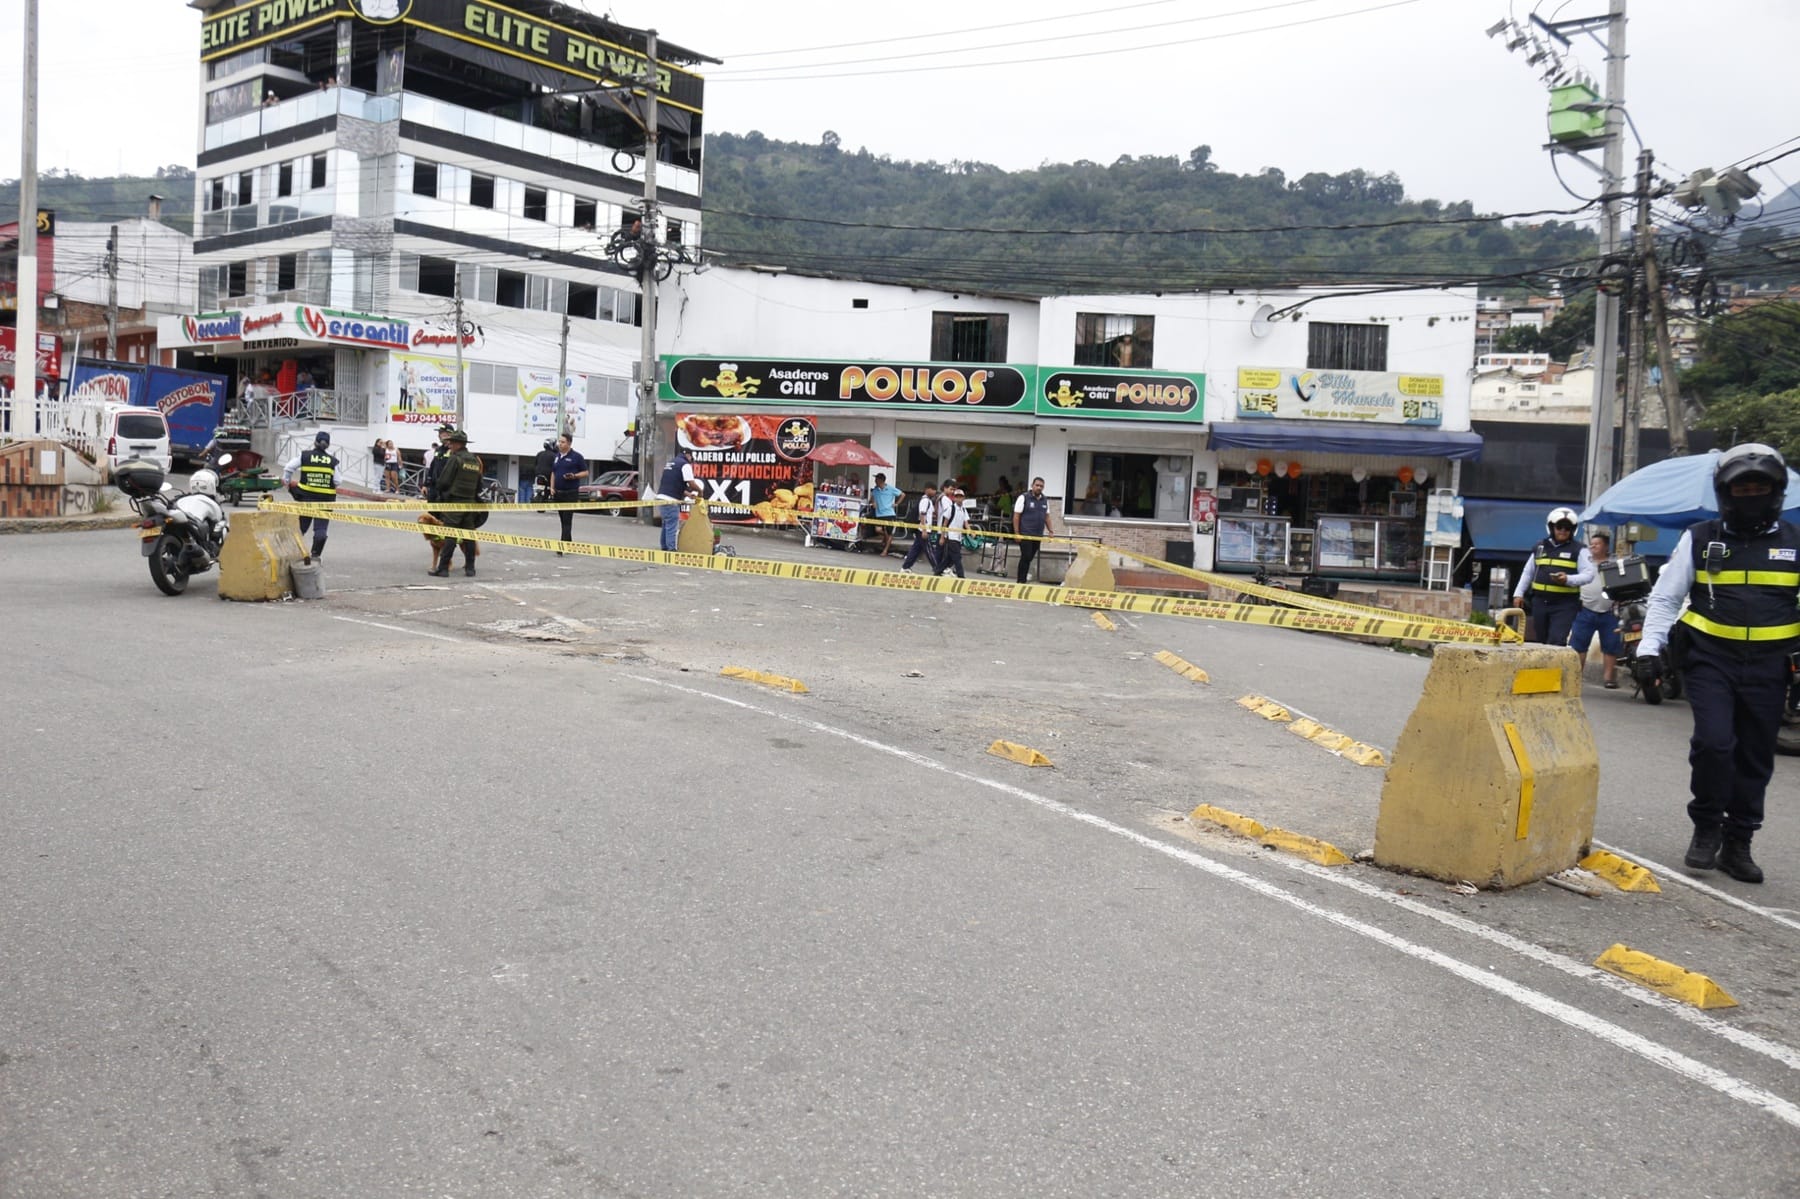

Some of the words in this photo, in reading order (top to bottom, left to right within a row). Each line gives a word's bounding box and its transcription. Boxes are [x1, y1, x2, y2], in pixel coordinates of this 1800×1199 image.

[201, 10, 251, 50] ELITE
[464, 4, 550, 54] ELITE
[420, 375, 453, 383] DESCUBRE
[768, 367, 829, 381] Asaderos
[779, 381, 817, 396] CALI
[839, 365, 988, 404] POLLOS
[158, 382, 210, 414] POSTOBON
[1088, 391, 1109, 400] CALI
[1115, 382, 1192, 407] POLLOS
[405, 414, 418, 422] 317
[420, 414, 436, 422] 044
[310, 454, 332, 465] M-29
[692, 451, 724, 462] SADERO
[725, 452, 744, 463] CALI
[746, 453, 777, 464] POLLOS
[692, 463, 717, 478] RAN
[722, 462, 792, 480] PROMOCIÓN
[1431, 624, 1466, 635] PELIGRO
[1466, 628, 1479, 636] NO
[1479, 628, 1502, 638] PASE
